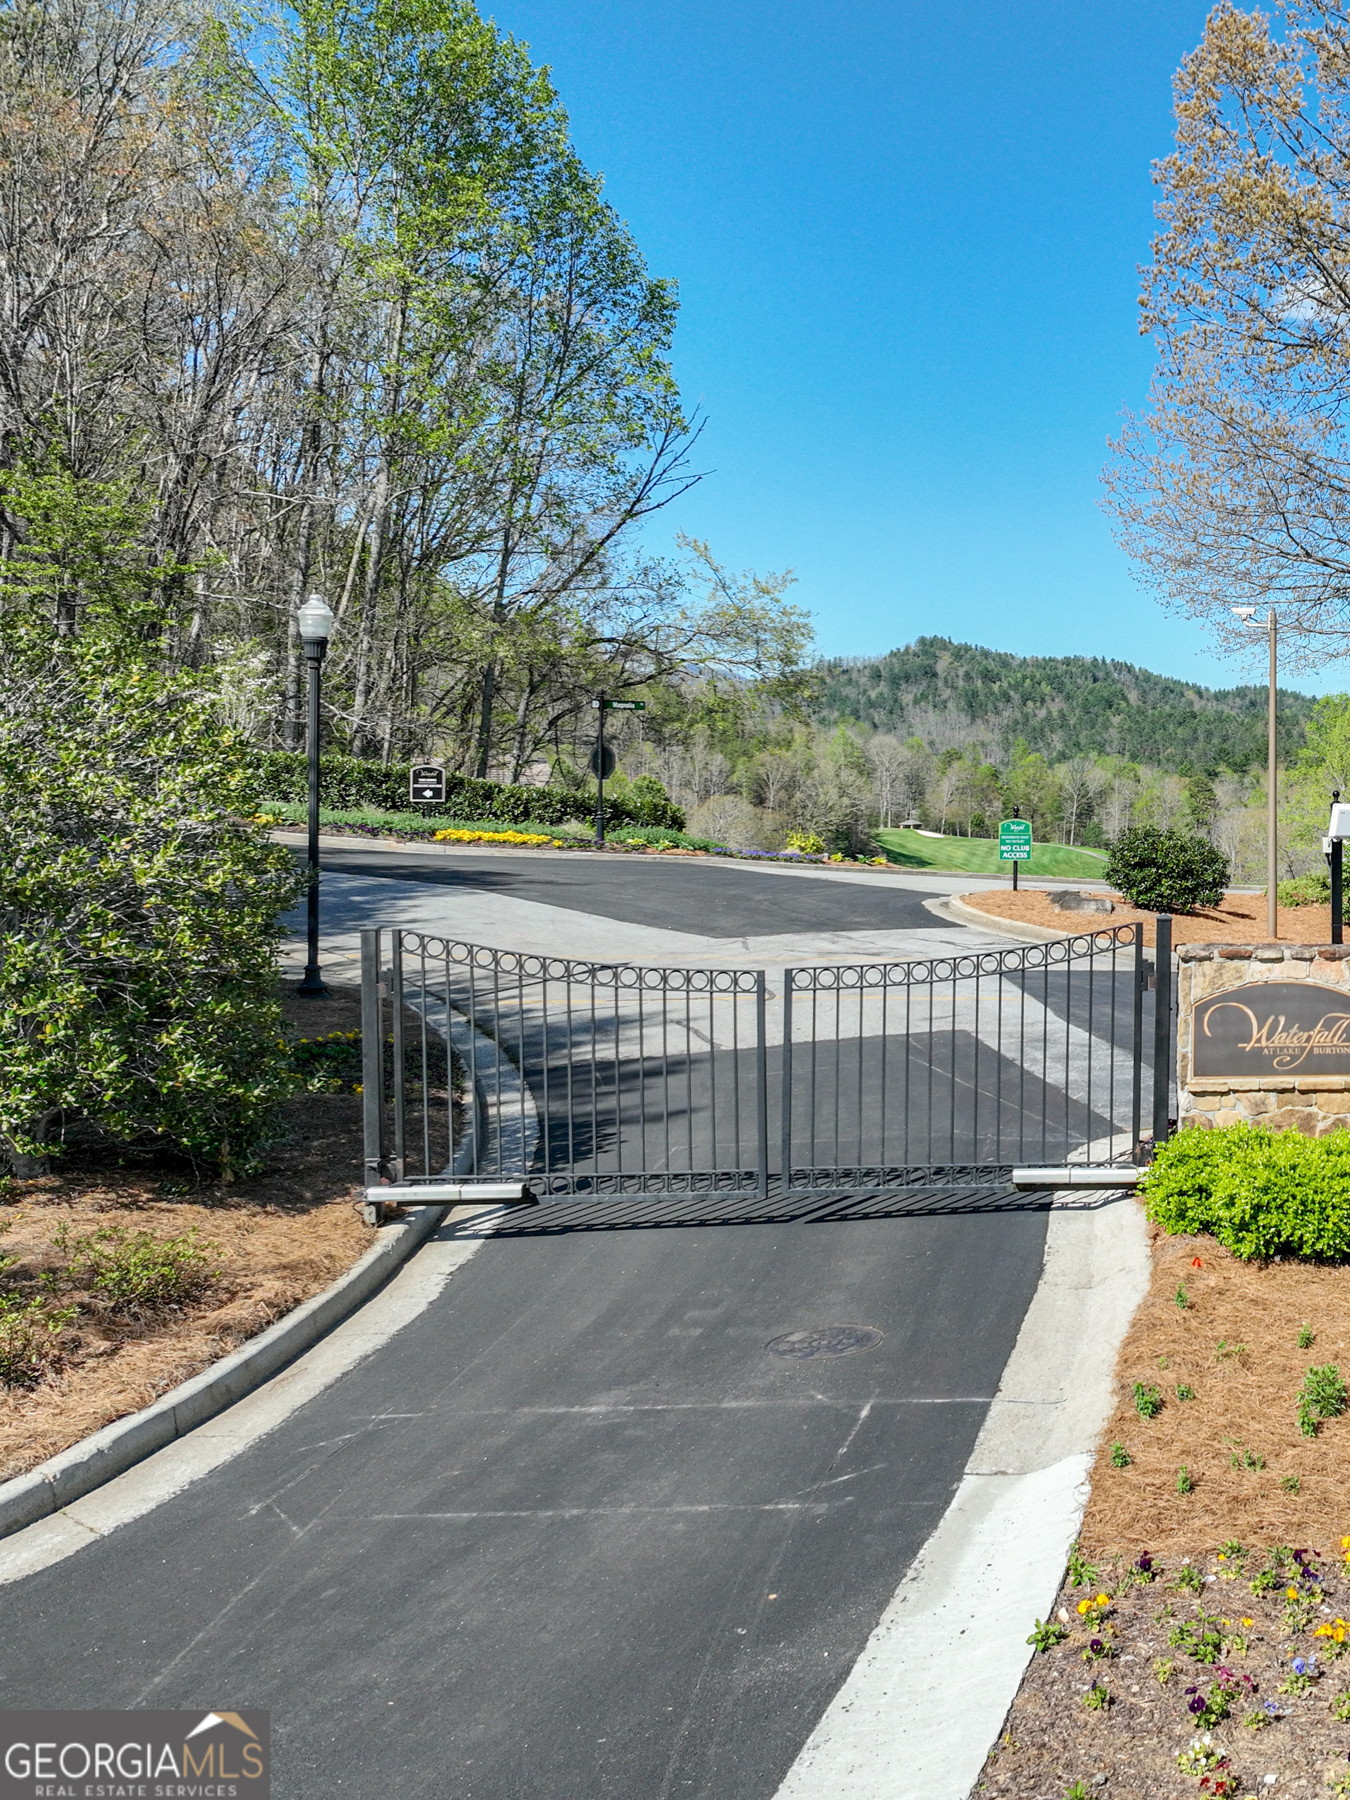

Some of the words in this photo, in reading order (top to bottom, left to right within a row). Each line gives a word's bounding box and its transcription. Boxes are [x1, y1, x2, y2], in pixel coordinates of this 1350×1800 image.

[1262, 1047, 1275, 1055] AT
[1276, 1047, 1300, 1055] LAKE
[1313, 1046, 1350, 1055] BURTON
